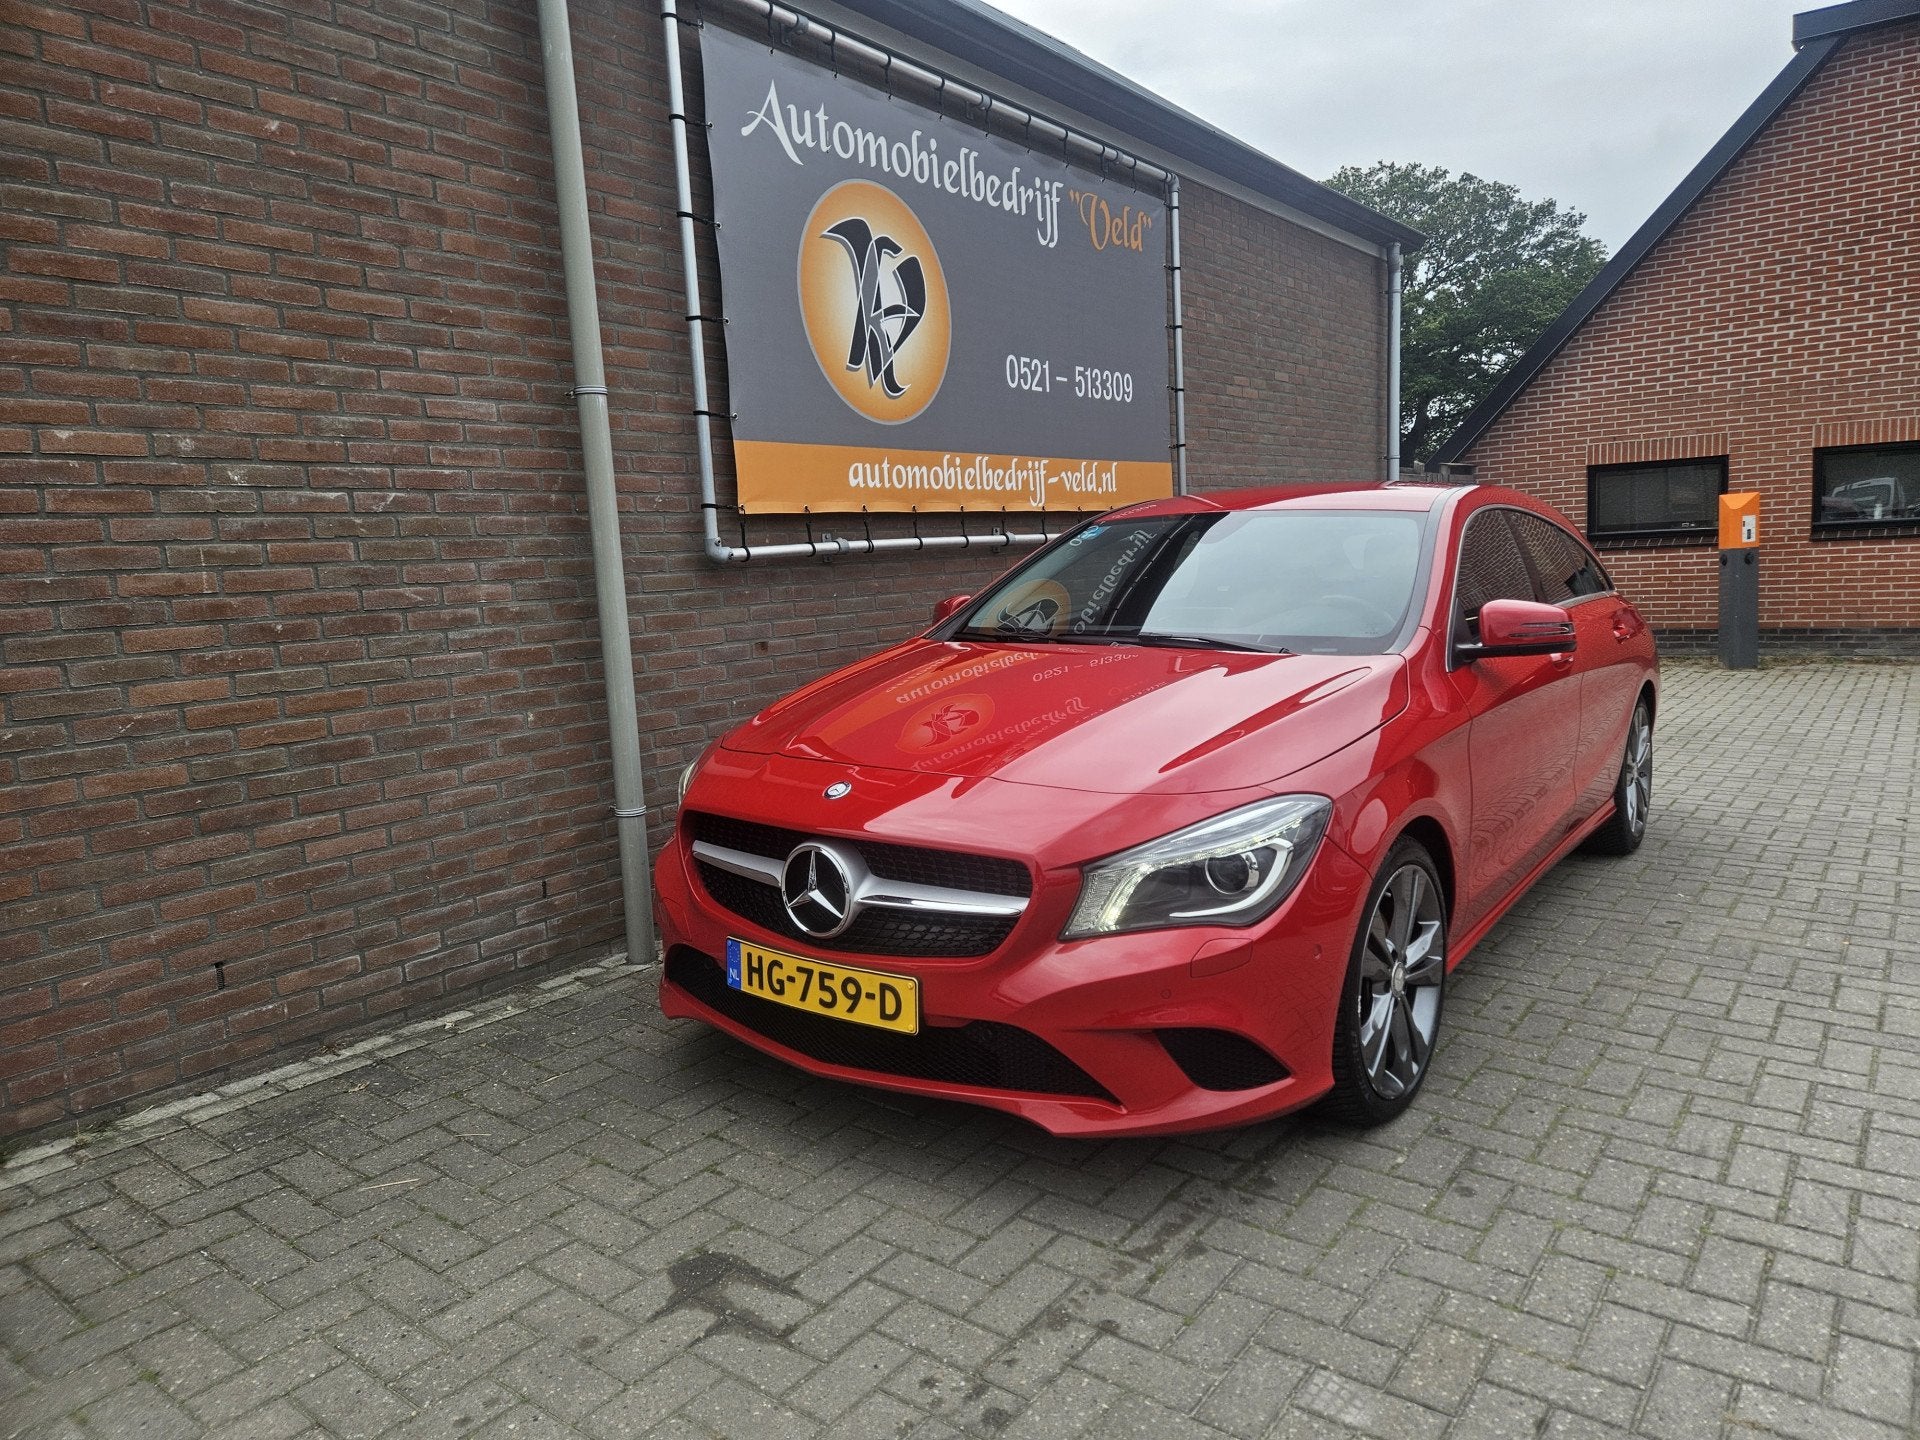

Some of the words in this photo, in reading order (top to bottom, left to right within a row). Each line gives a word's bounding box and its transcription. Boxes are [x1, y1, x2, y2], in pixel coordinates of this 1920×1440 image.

[741, 79, 1064, 248] Automobielbedrijf
[1006, 355, 1051, 393] 0521
[1075, 366, 1133, 403] 513309
[849, 454, 1118, 507] automobielbedrijf-veld.nl
[729, 967, 740, 981] NL
[747, 951, 902, 1021] HG-759-D
